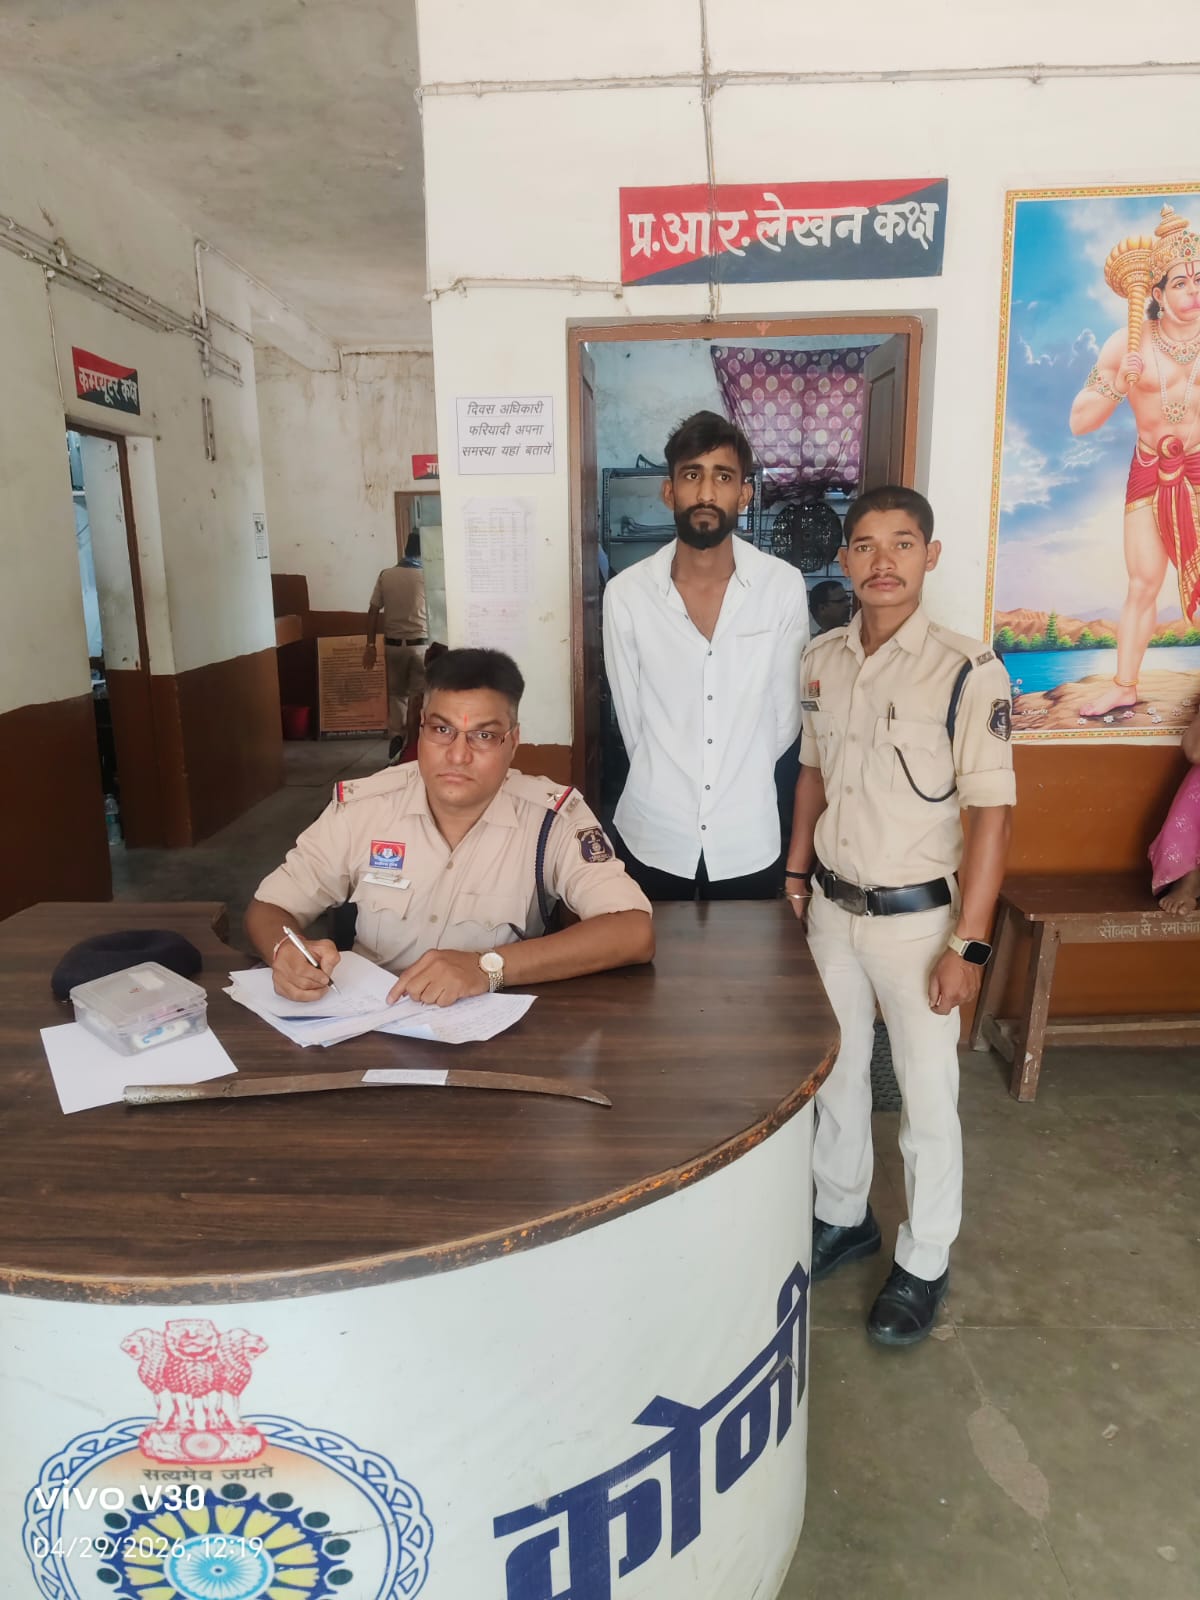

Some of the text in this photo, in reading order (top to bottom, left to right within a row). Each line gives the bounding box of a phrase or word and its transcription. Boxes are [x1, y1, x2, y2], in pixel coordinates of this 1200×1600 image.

[754, 192, 869, 252] लेखन
[873, 200, 940, 250] कक्ष
[467, 400, 544, 415] दिवस अधिकारी
[469, 422, 544, 436] फरियादी अपना
[462, 446, 497, 457] समस्या
[142, 1462, 275, 1481] सत्यमेव जयते
